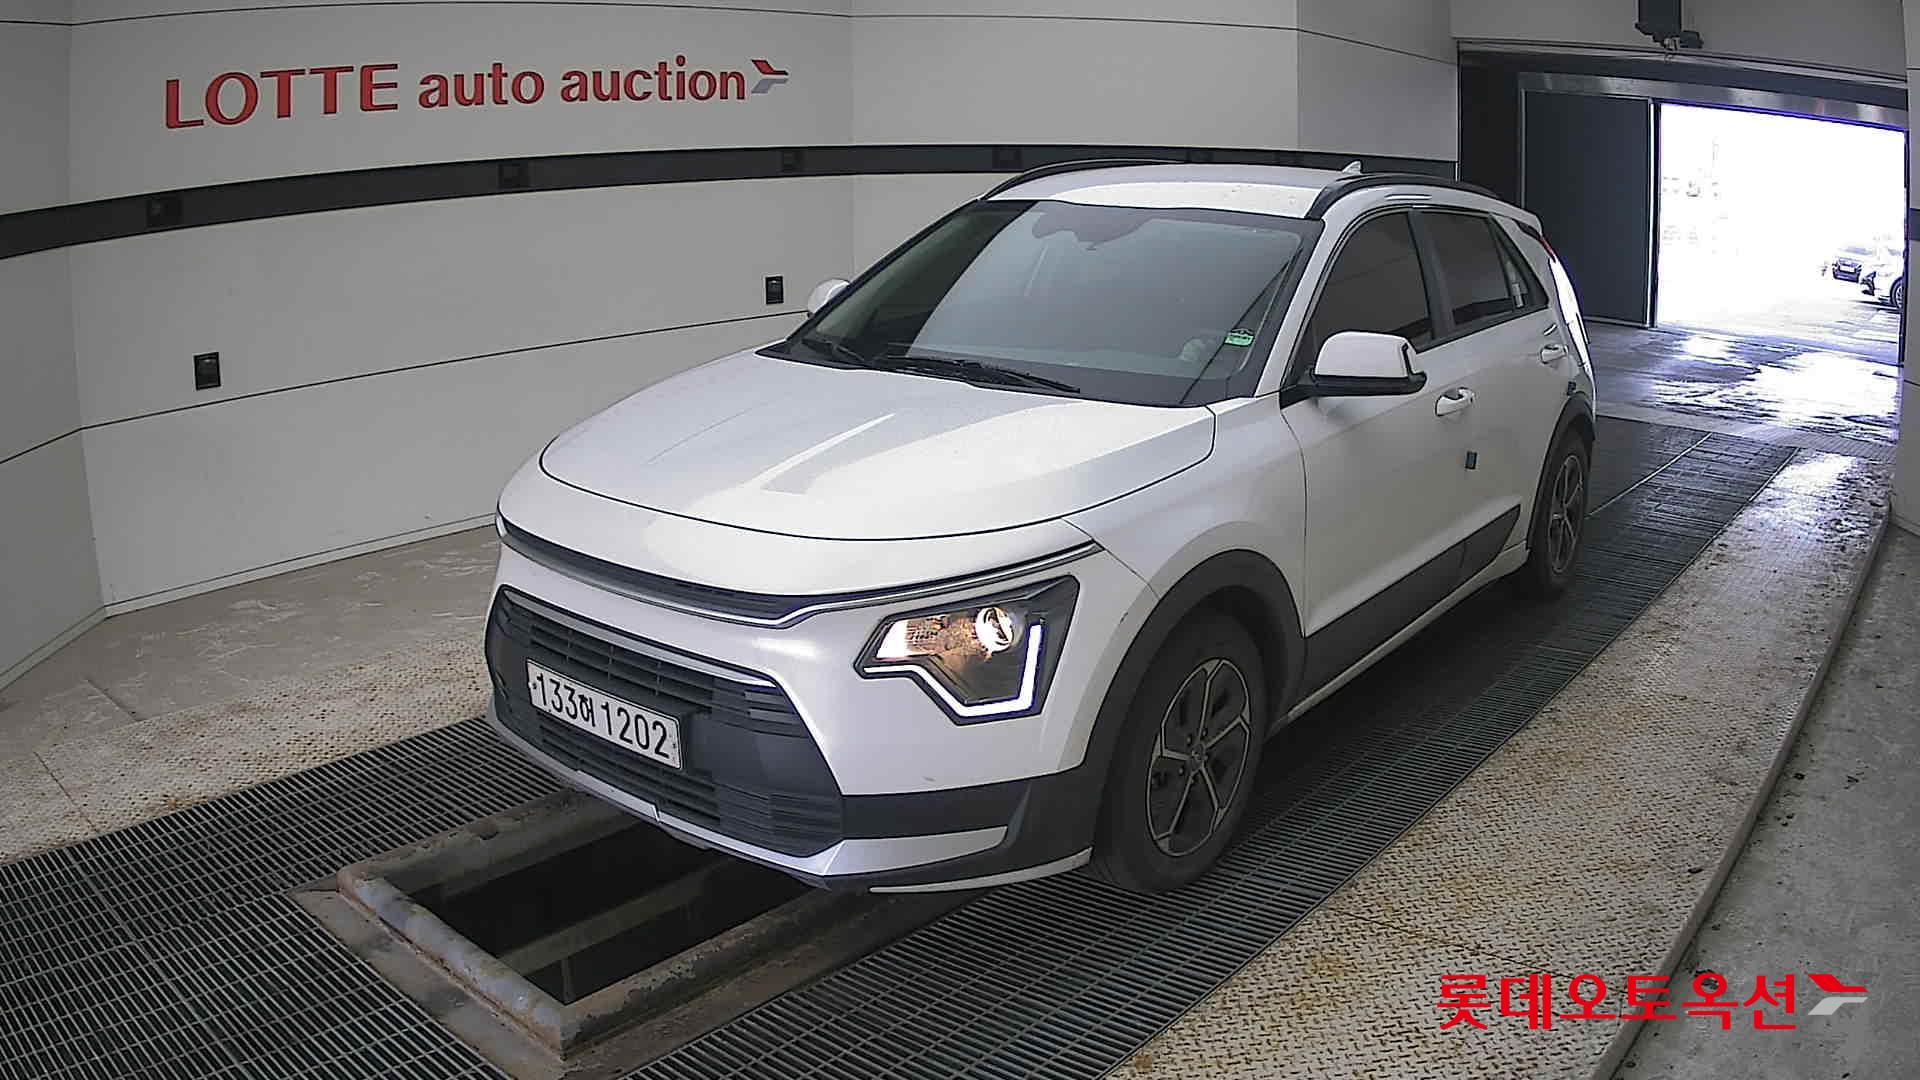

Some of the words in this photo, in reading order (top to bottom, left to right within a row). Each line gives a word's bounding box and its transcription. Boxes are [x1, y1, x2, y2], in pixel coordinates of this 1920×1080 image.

[165, 63, 399, 129] LOTTE
[418, 63, 546, 109] auto
[560, 54, 747, 102] auction
[600, 701, 670, 758] 1202
